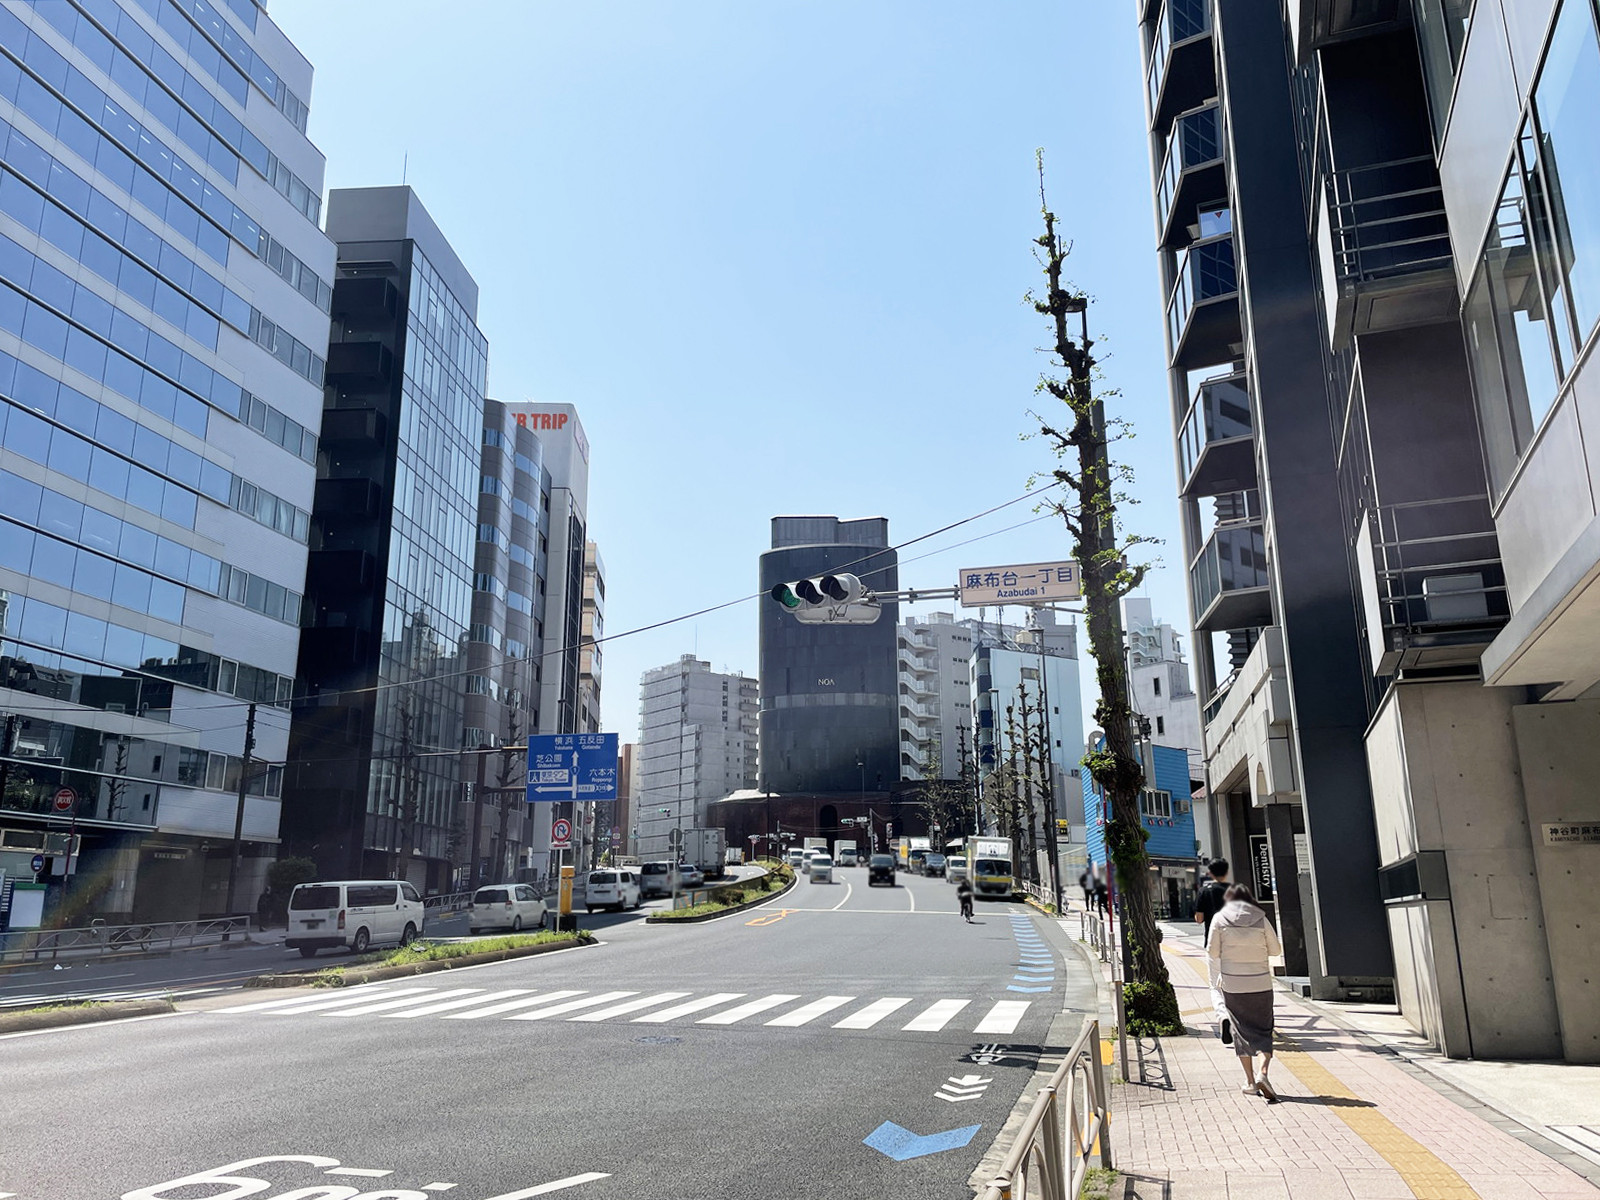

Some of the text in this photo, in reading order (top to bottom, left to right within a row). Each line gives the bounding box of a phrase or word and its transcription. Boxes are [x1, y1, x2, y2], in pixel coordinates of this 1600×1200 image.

[511, 413, 568, 430] R TRIP
[966, 568, 1072, 588] 麻布台一丁目
[997, 587, 1046, 598] Azabudai 1
[579, 736, 604, 744] 五反田
[589, 768, 615, 776] 六本木
[1260, 843, 1270, 887] Dentistry
